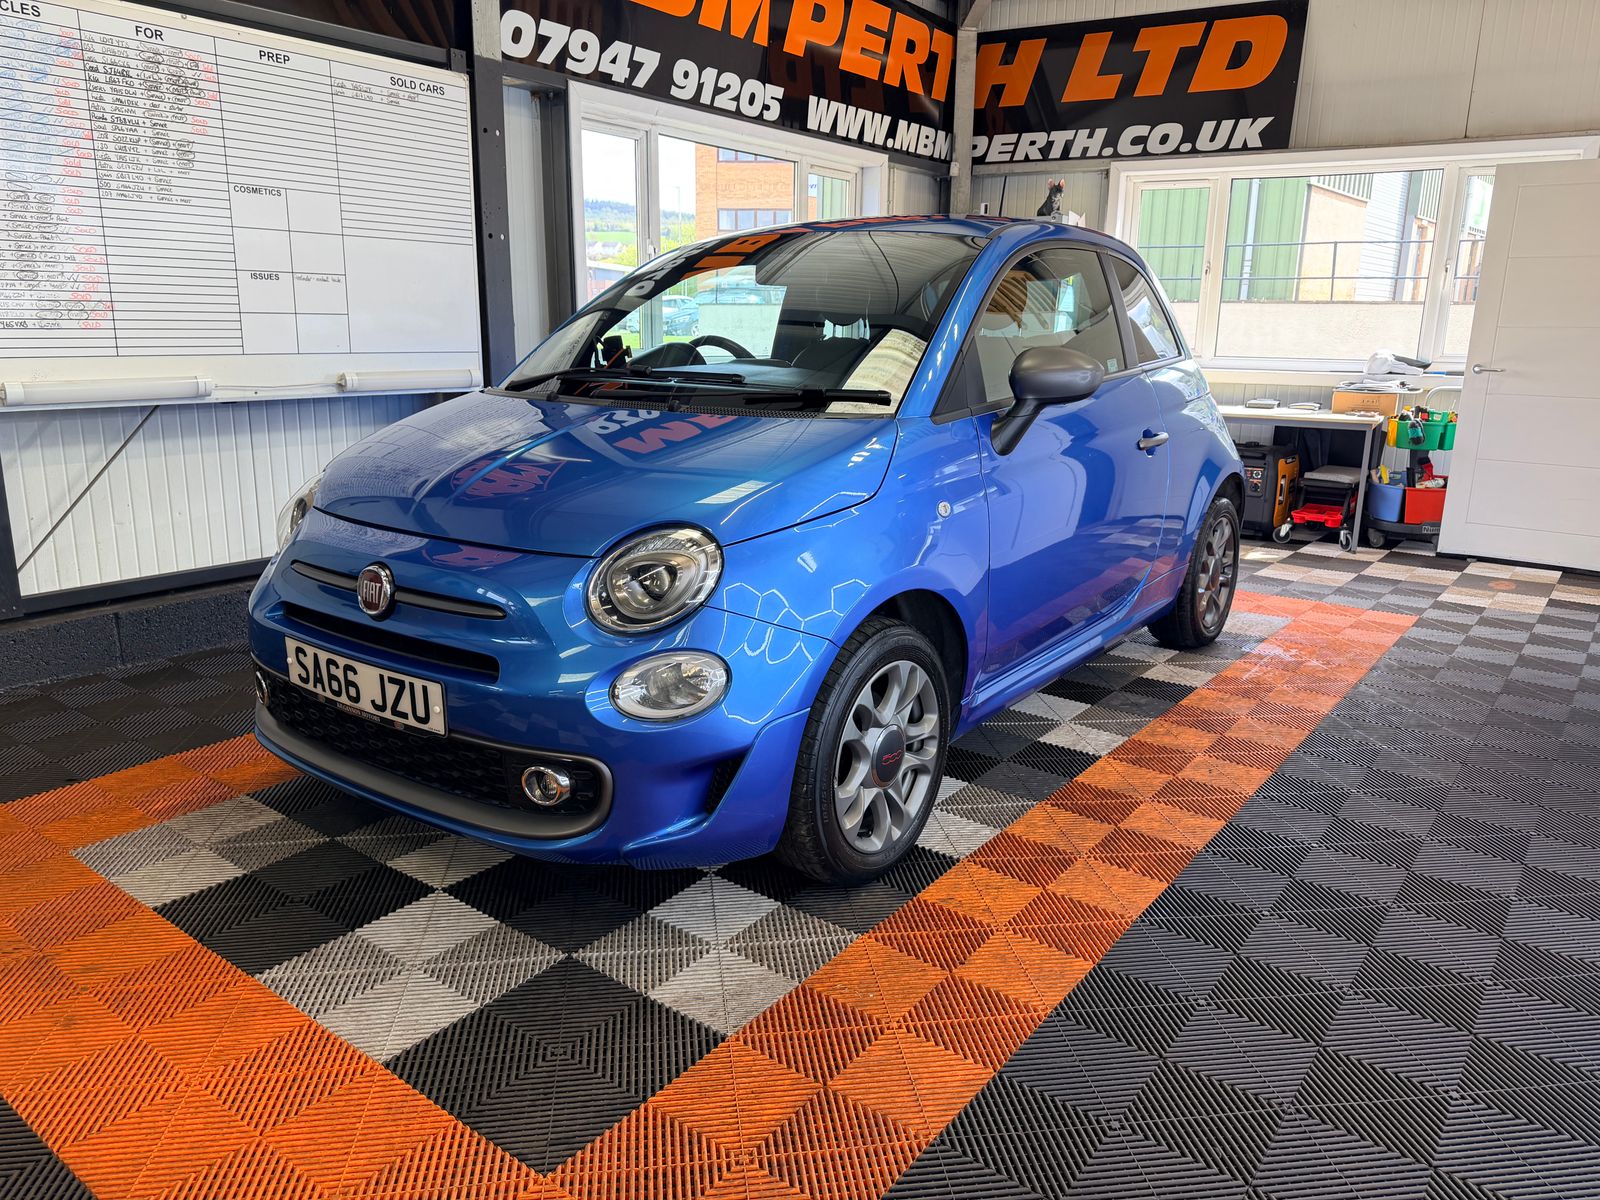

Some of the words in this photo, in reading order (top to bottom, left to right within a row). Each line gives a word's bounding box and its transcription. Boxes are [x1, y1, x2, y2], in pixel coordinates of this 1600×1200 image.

[135, 25, 164, 41] FOR
[259, 50, 290, 65] PREP
[501, 9, 661, 88] 07947
[670, 58, 785, 122] 91205
[1061, 14, 1288, 103] LTD
[390, 76, 416, 91] SOLD
[419, 81, 445, 96] CARS
[233, 184, 282, 197] COSMETICS
[250, 272, 280, 281] ISSUES
[363, 580, 381, 603] FIAT
[295, 646, 361, 704] SA66
[371, 674, 430, 725] JZU
